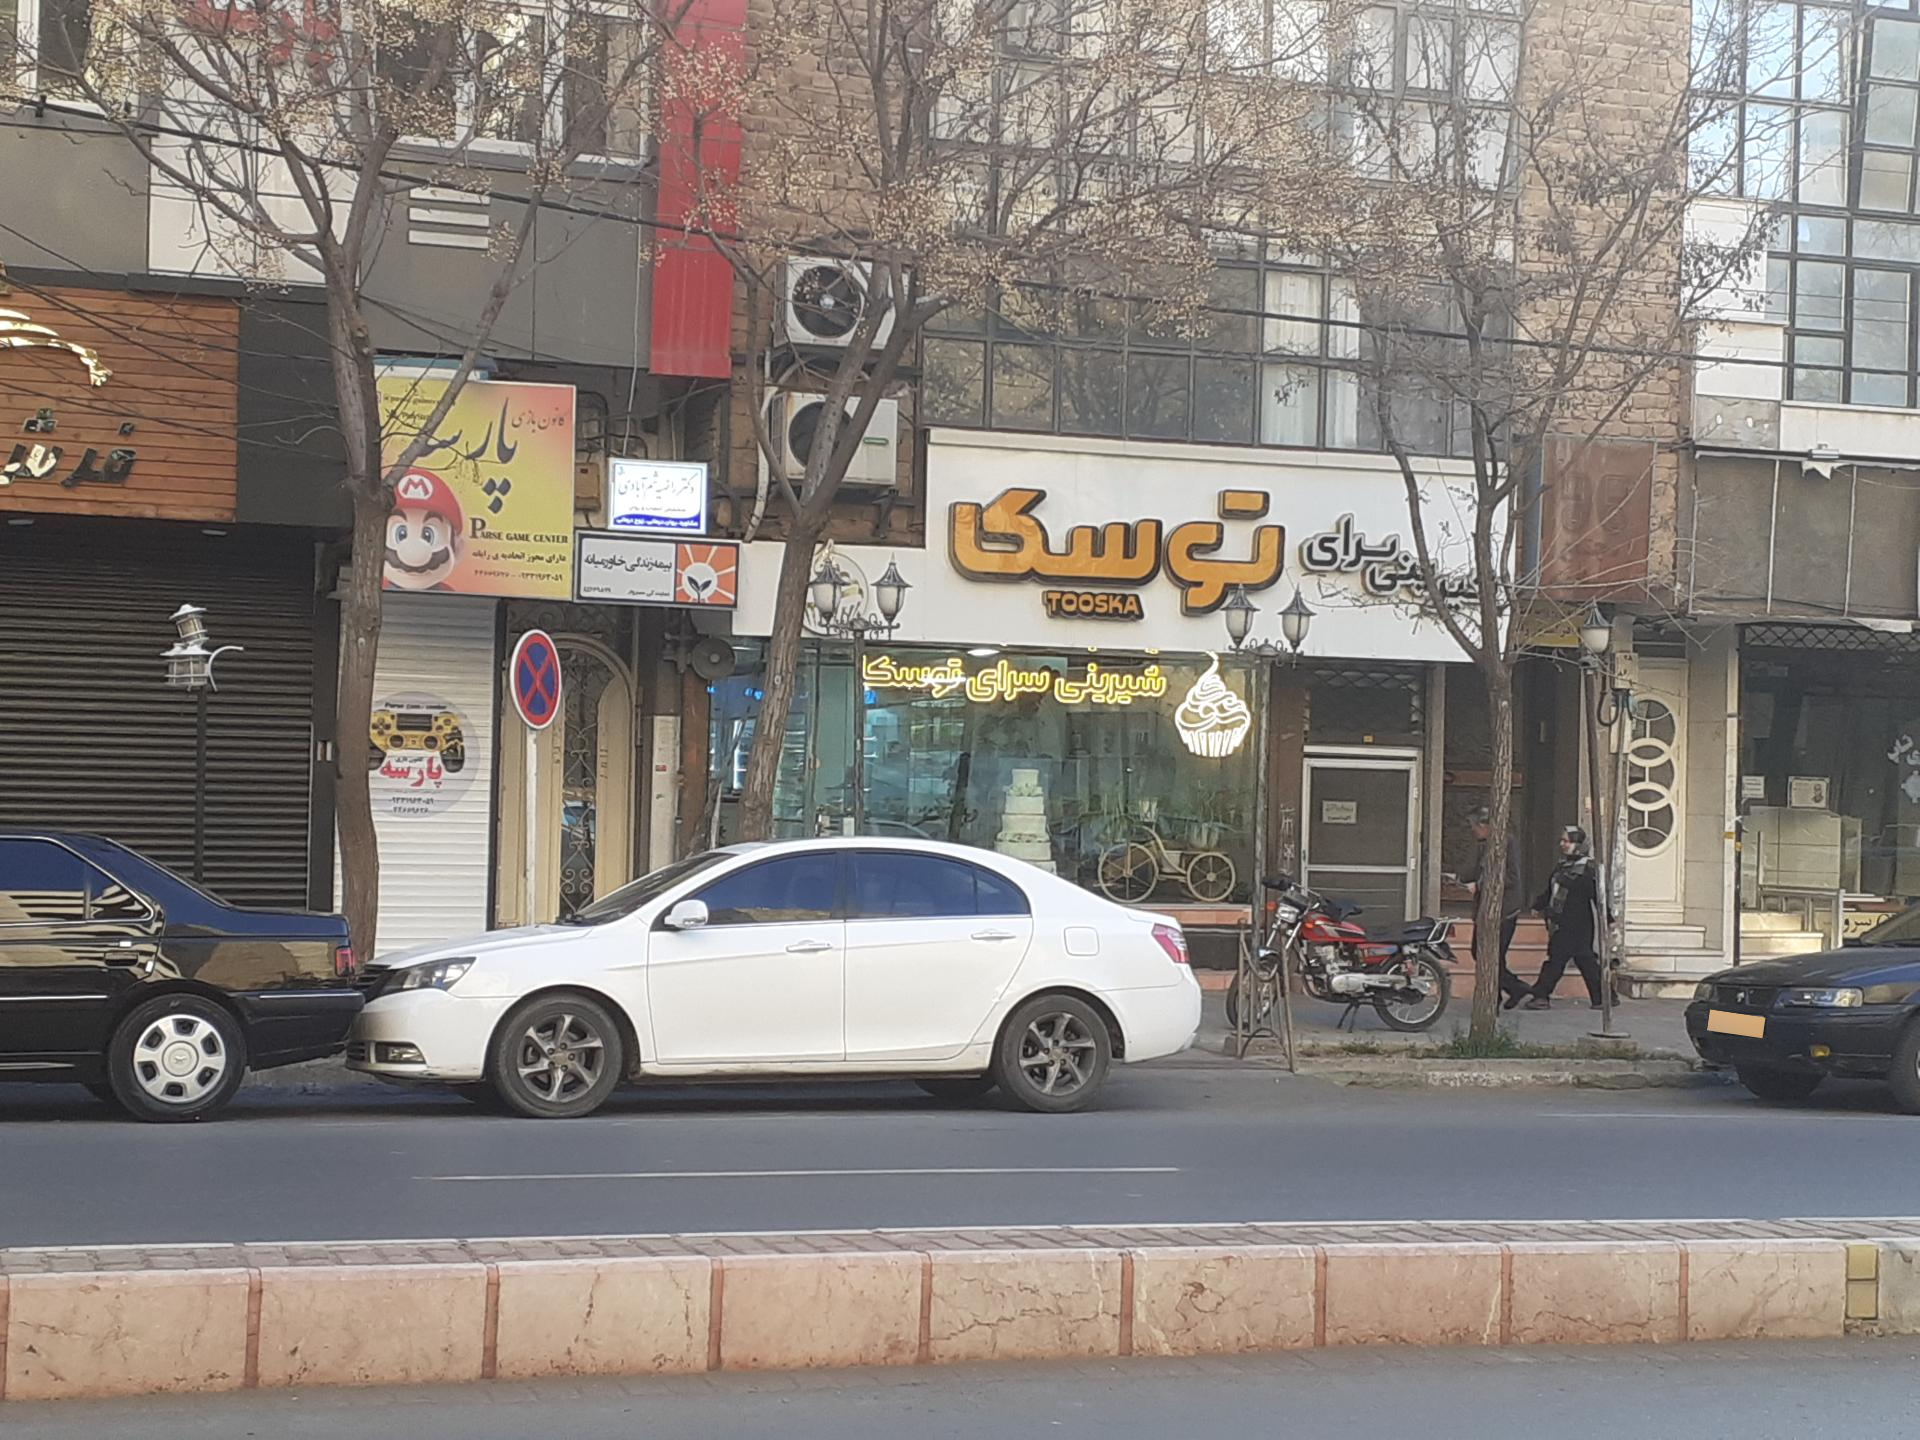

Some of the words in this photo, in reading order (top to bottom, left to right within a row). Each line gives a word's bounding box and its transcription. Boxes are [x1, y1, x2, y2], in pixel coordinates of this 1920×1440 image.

[510, 409, 537, 433] بازی
[949, 487, 1286, 617] توسکا
[1044, 590, 1143, 618] TOOSKA
[862, 654, 965, 699] توسکا
[966, 659, 1050, 701] سرای
[1054, 662, 1167, 705] شیرینی
